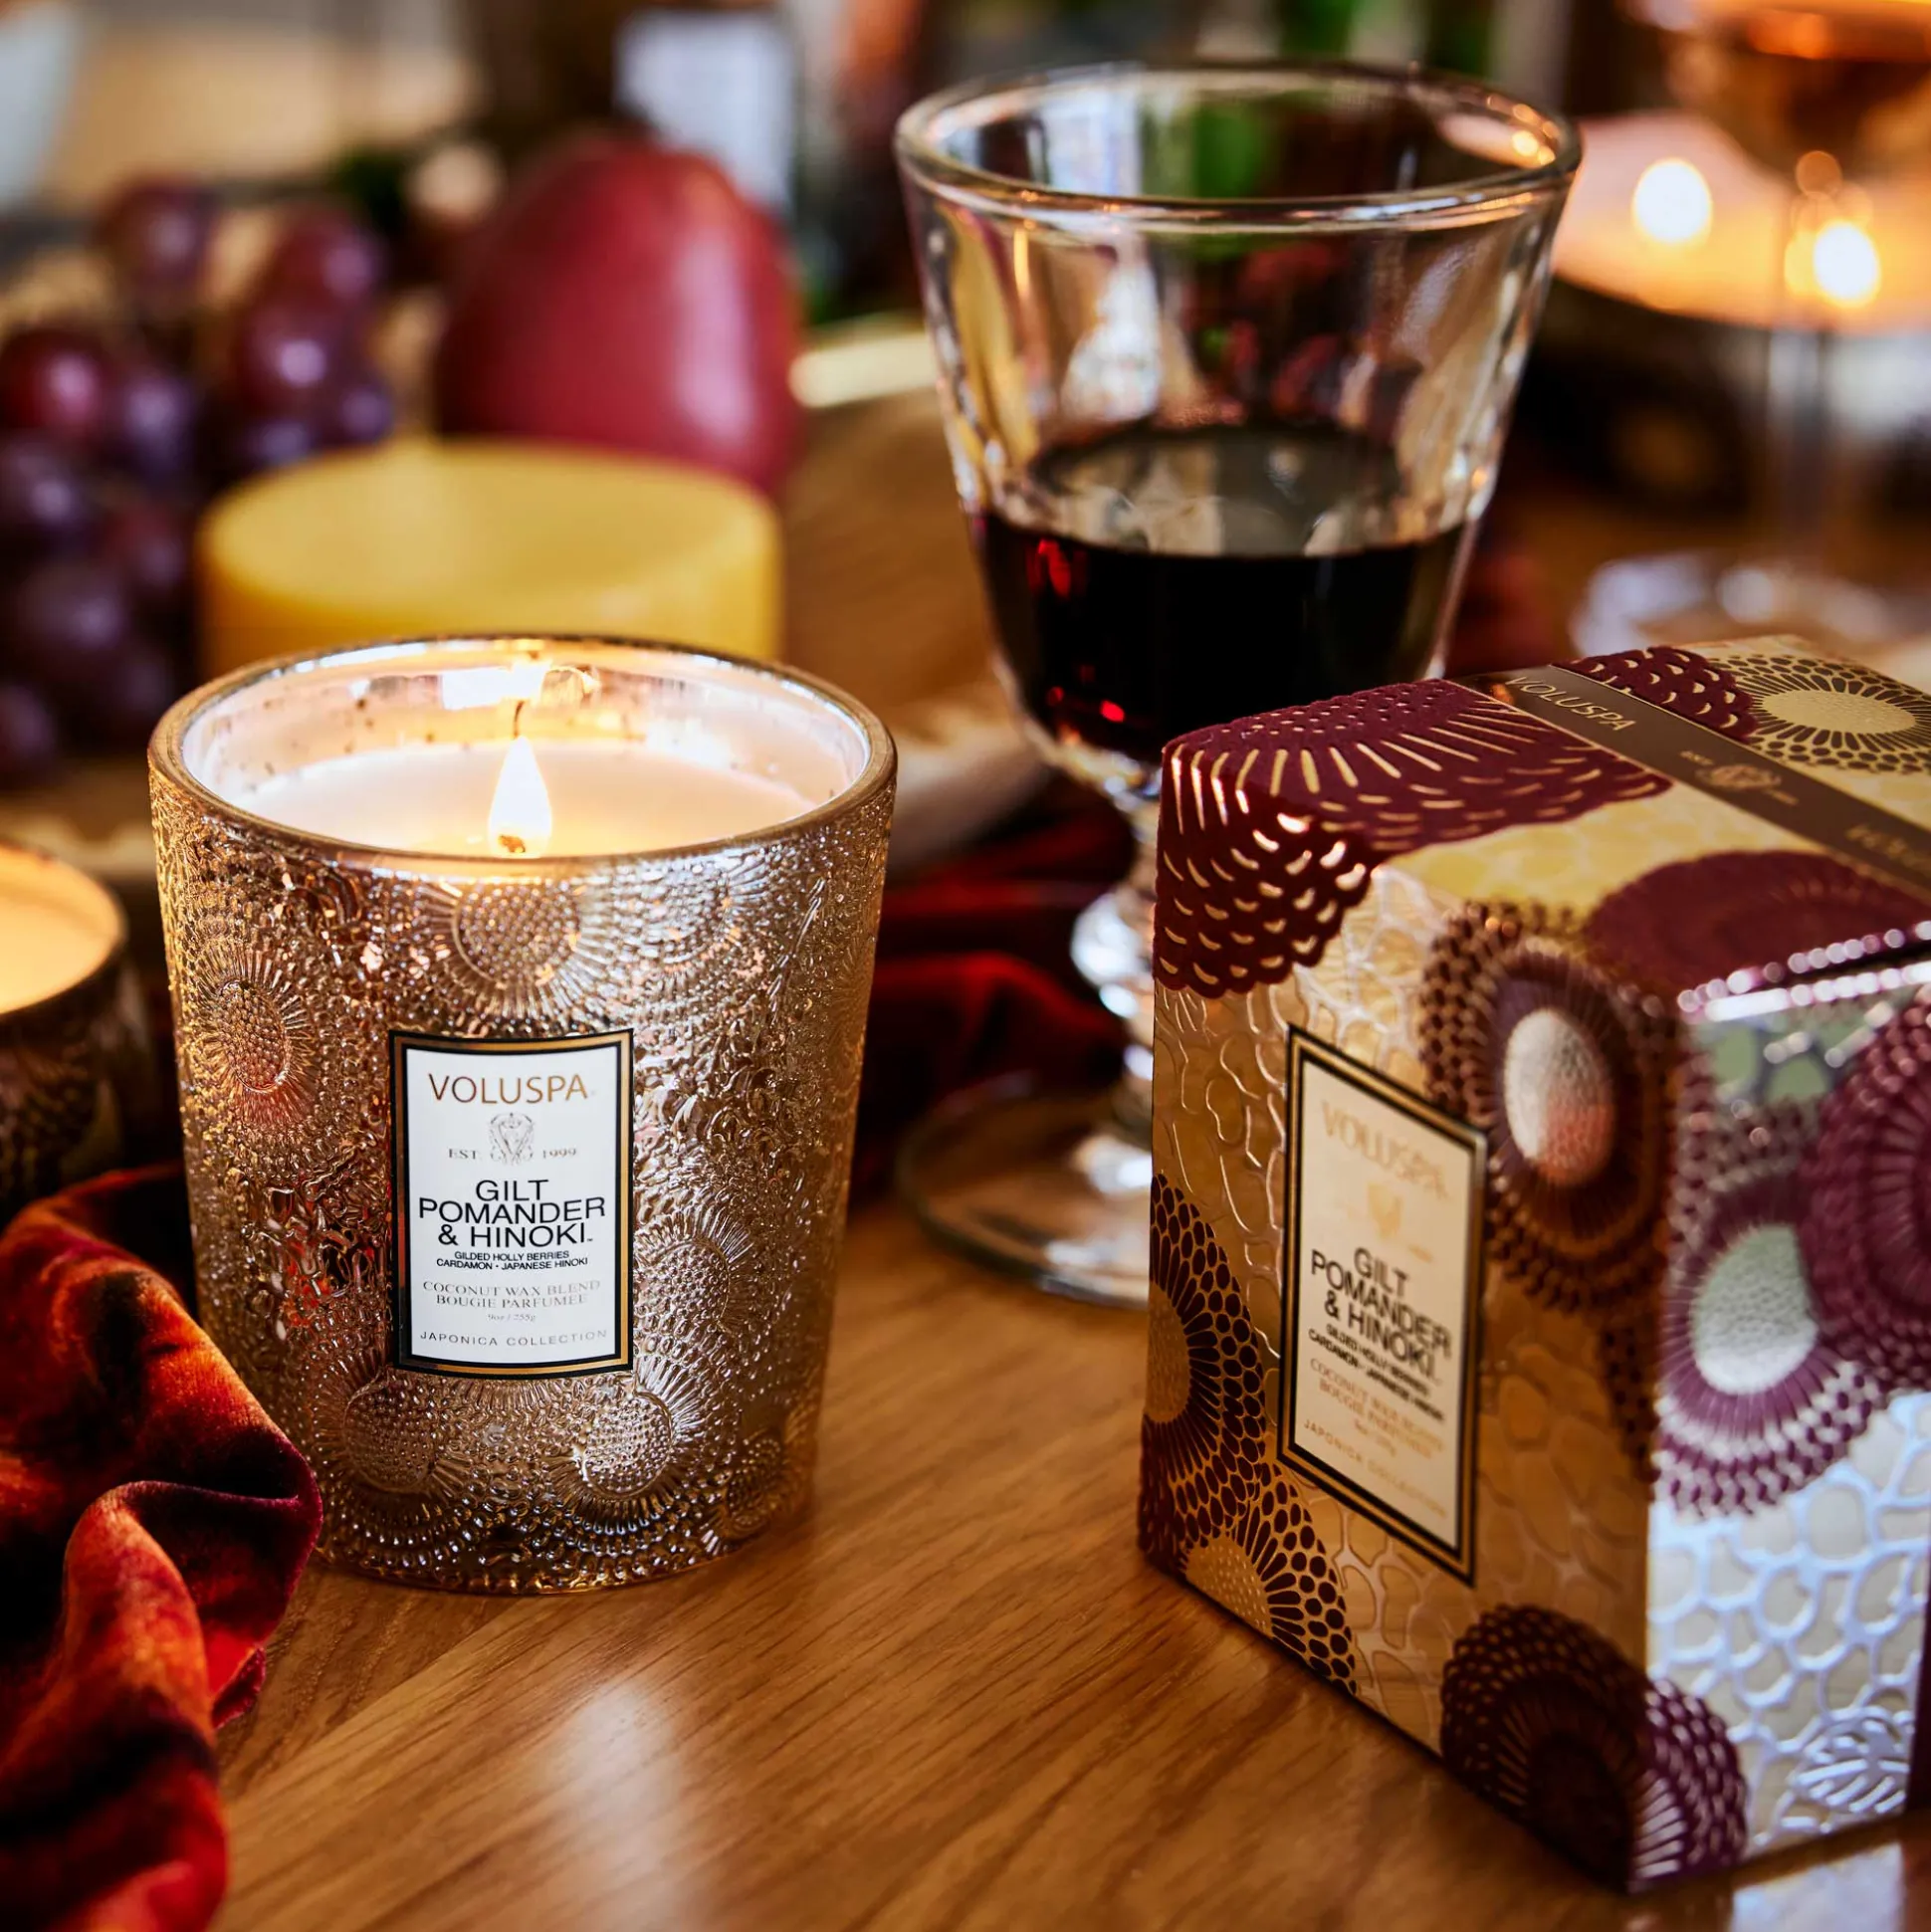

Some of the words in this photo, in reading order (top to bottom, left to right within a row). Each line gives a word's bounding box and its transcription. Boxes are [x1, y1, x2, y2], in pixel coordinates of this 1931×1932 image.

[1505, 676, 1636, 731] VOLUSPA
[429, 1073, 588, 1104] VOLUSPA
[542, 1148, 576, 1159] 1999
[476, 1180, 548, 1201] GILT
[419, 1196, 605, 1224] POMANDER
[438, 1224, 458, 1246] &
[436, 1258, 493, 1270] CARDAMON
[501, 1261, 552, 1270] JAPANESE
[554, 1257, 588, 1268] HINOKI
[454, 1251, 491, 1261] GILDED
[493, 1251, 525, 1261] HOLLY
[527, 1250, 569, 1261] BERRIES
[1354, 1247, 1409, 1298] GILT
[423, 1280, 502, 1296] COCONUT
[506, 1287, 540, 1296] WAX
[546, 1280, 601, 1296] BLEND
[436, 1294, 497, 1309] BOUGIE
[1311, 1249, 1453, 1360] POMANDER
[1324, 1289, 1340, 1320] &
[420, 1331, 498, 1347] JAPONICA
[506, 1329, 608, 1347] COLLECTION
